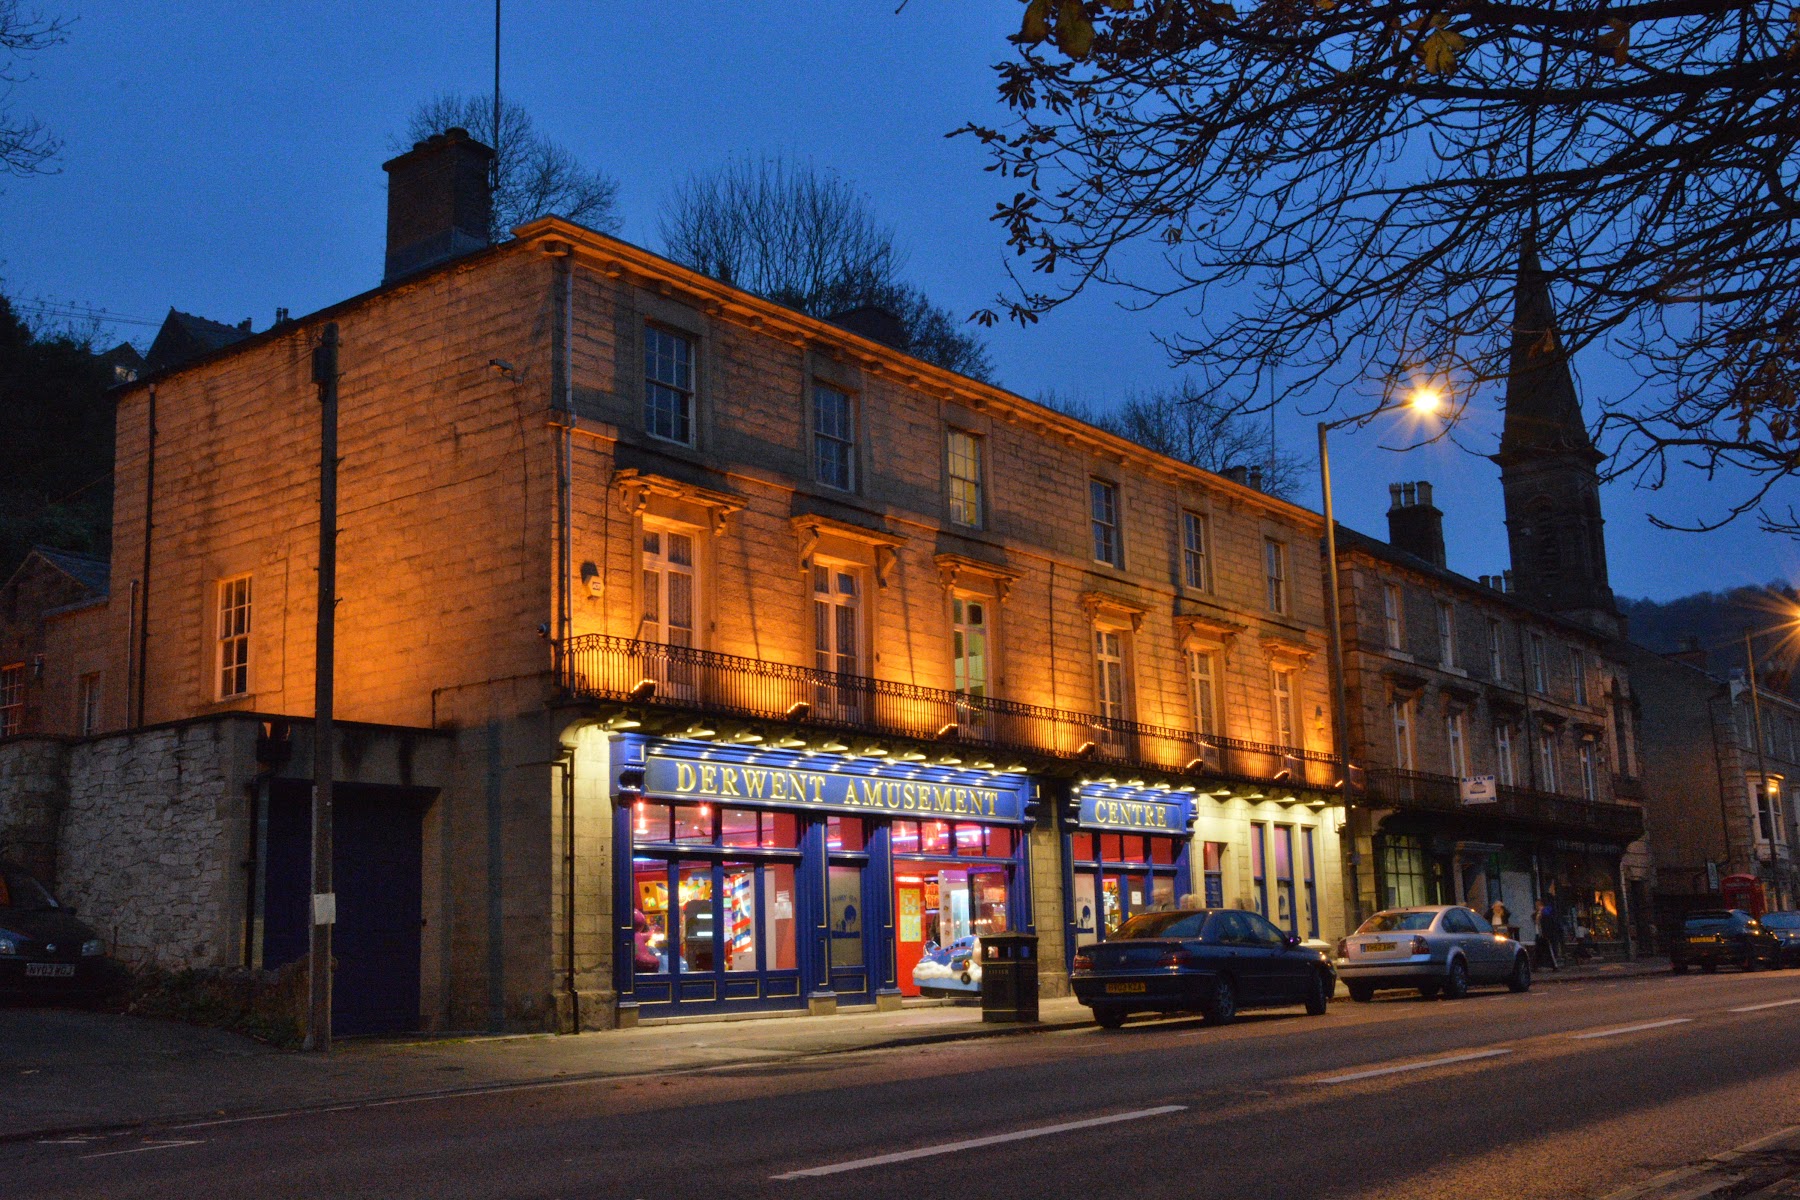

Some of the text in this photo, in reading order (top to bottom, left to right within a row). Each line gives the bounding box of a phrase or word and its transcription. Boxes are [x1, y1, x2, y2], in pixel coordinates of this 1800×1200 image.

[676, 761, 998, 816] DERWENT AMUSEMENT
[1095, 800, 1167, 827] CENTRE
